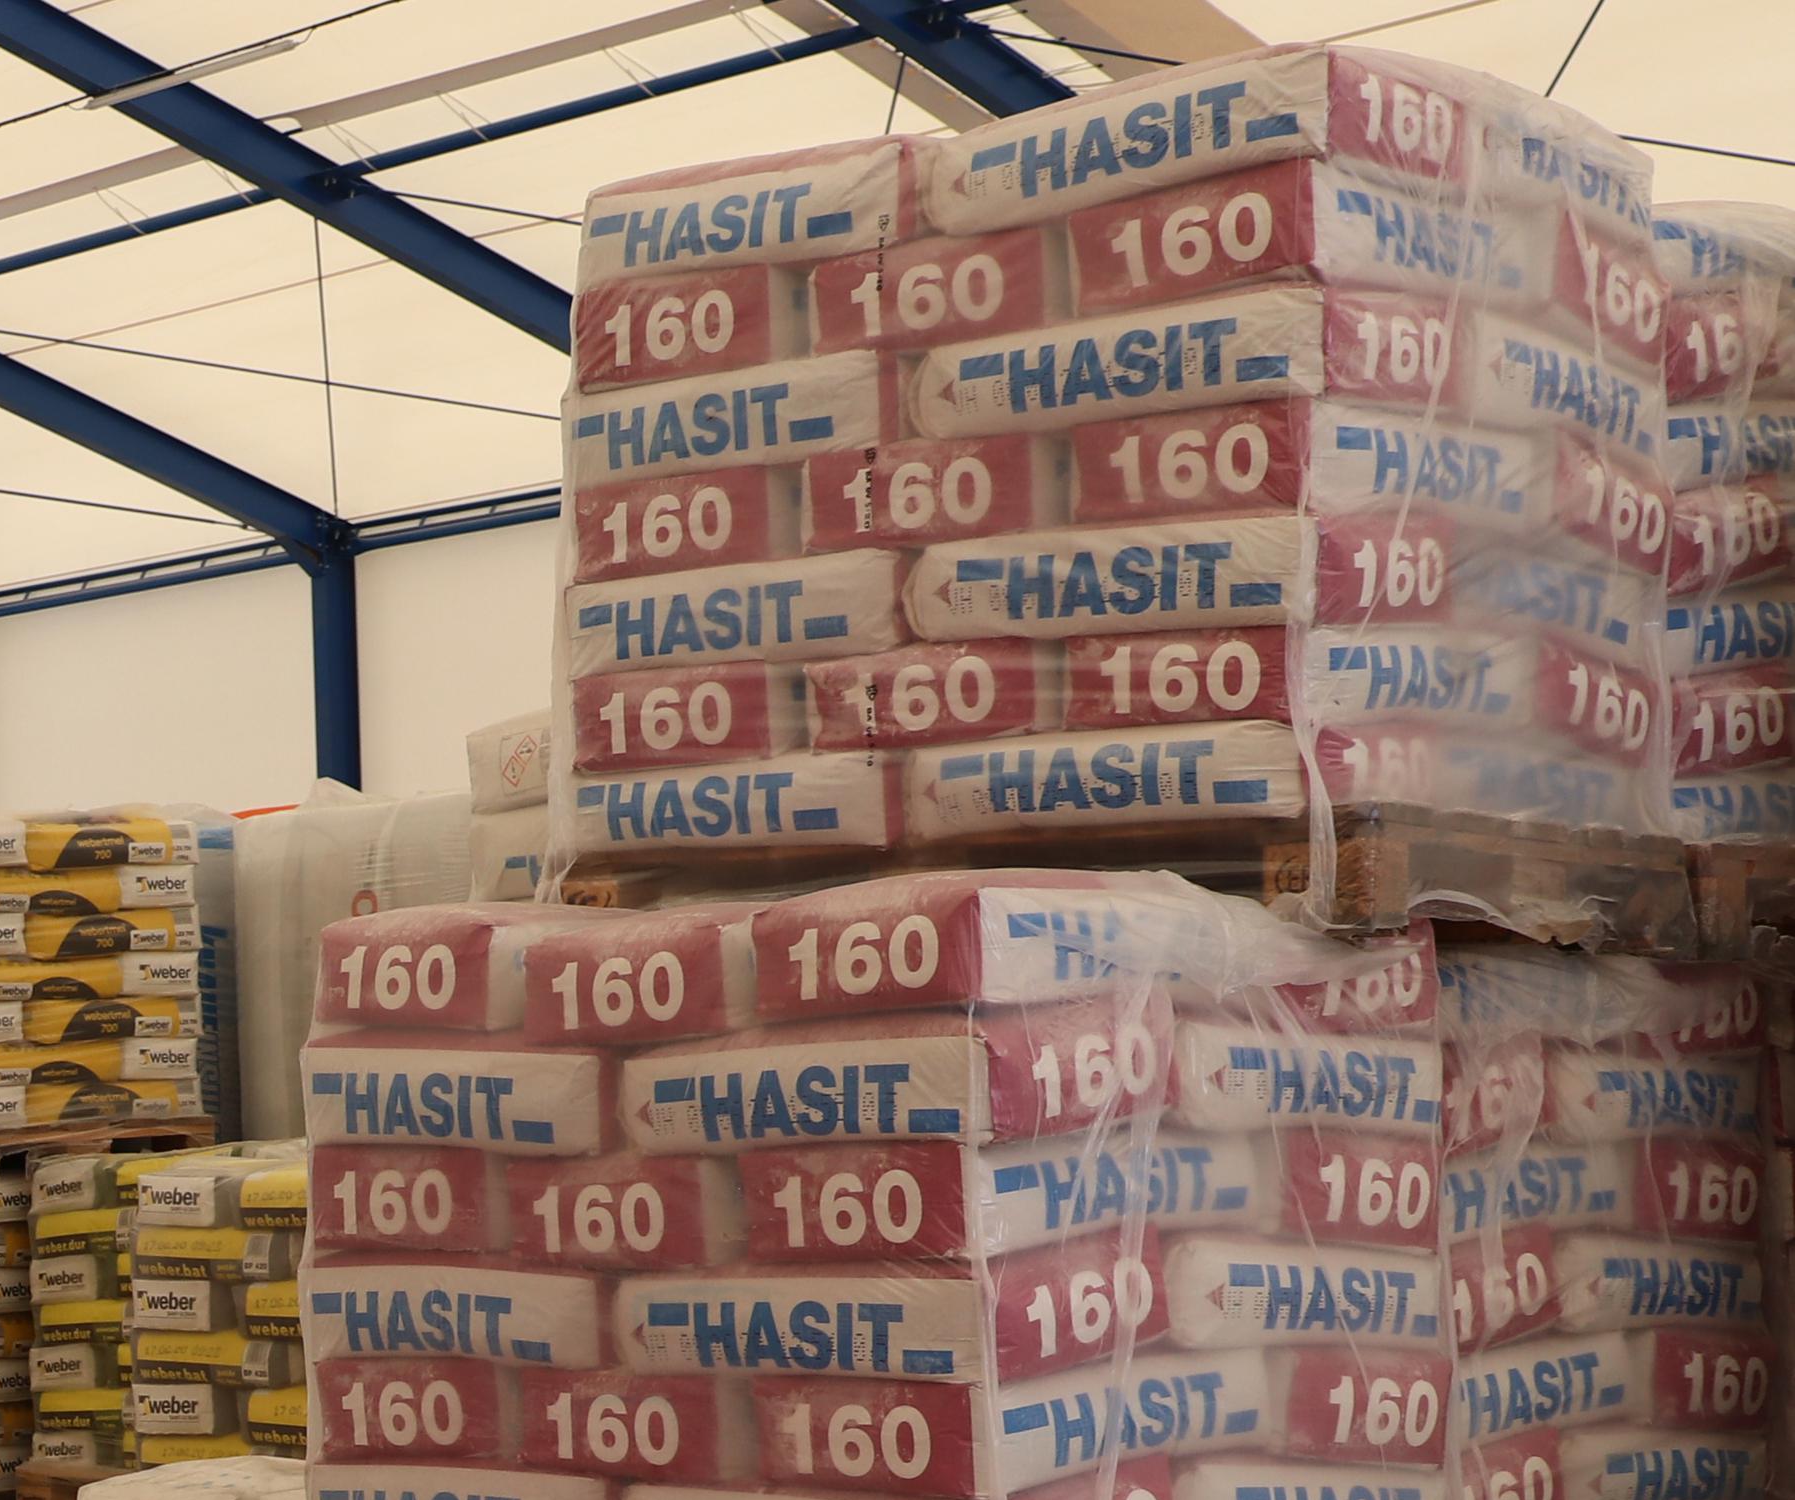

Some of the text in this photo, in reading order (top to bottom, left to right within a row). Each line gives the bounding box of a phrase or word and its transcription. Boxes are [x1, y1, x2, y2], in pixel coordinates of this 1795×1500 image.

[1020, 81, 1246, 196] HASIT
[1360, 75, 1453, 160] 160
[623, 183, 811, 267] HASIT
[1111, 192, 1273, 288] 160
[606, 289, 734, 367] 160
[851, 254, 1004, 336] 160
[1009, 319, 1236, 413] HASIT
[1357, 310, 1451, 384] 160
[607, 384, 788, 469] HASIT
[1110, 422, 1268, 499] 160
[603, 487, 731, 563] 160
[843, 457, 991, 532] 160
[1006, 542, 1231, 619] HASIT
[1353, 538, 1443, 608] 160
[615, 580, 804, 660] HASIT
[845, 656, 995, 735] 160
[1101, 640, 1260, 713] 160
[1569, 662, 1651, 750] 160
[600, 682, 731, 754] 160
[604, 772, 793, 841] HASIT
[987, 739, 1213, 814] HASIT
[146, 877, 187, 892] weber
[149, 965, 191, 980] weber
[339, 943, 456, 1010] 160
[551, 951, 684, 1030] 160
[787, 915, 939, 1001] 160
[148, 1050, 190, 1065] weber
[1033, 1022, 1155, 1117] 160
[1269, 1048, 1416, 1119] HASIT
[342, 1072, 513, 1141] HASIT
[697, 1064, 909, 1144] HASIT
[152, 1188, 200, 1206] weber
[333, 1168, 453, 1235] 160
[533, 1182, 665, 1253] 160
[773, 1169, 922, 1248] 160
[1320, 1154, 1431, 1228] 160
[139, 1262, 208, 1278] weber.bat
[147, 1291, 196, 1311] weber
[1026, 1256, 1154, 1358] 160
[1265, 1264, 1415, 1334] HASIT
[342, 1290, 512, 1356] HASIT
[691, 1300, 903, 1373] HASIT
[149, 1396, 198, 1414] weber
[341, 1381, 464, 1446] 160
[547, 1393, 679, 1465] 160
[1047, 1372, 1224, 1467] HASIT
[1329, 1376, 1439, 1447] 160
[1464, 1352, 1599, 1438] HASIT
[782, 1402, 931, 1479] 160
